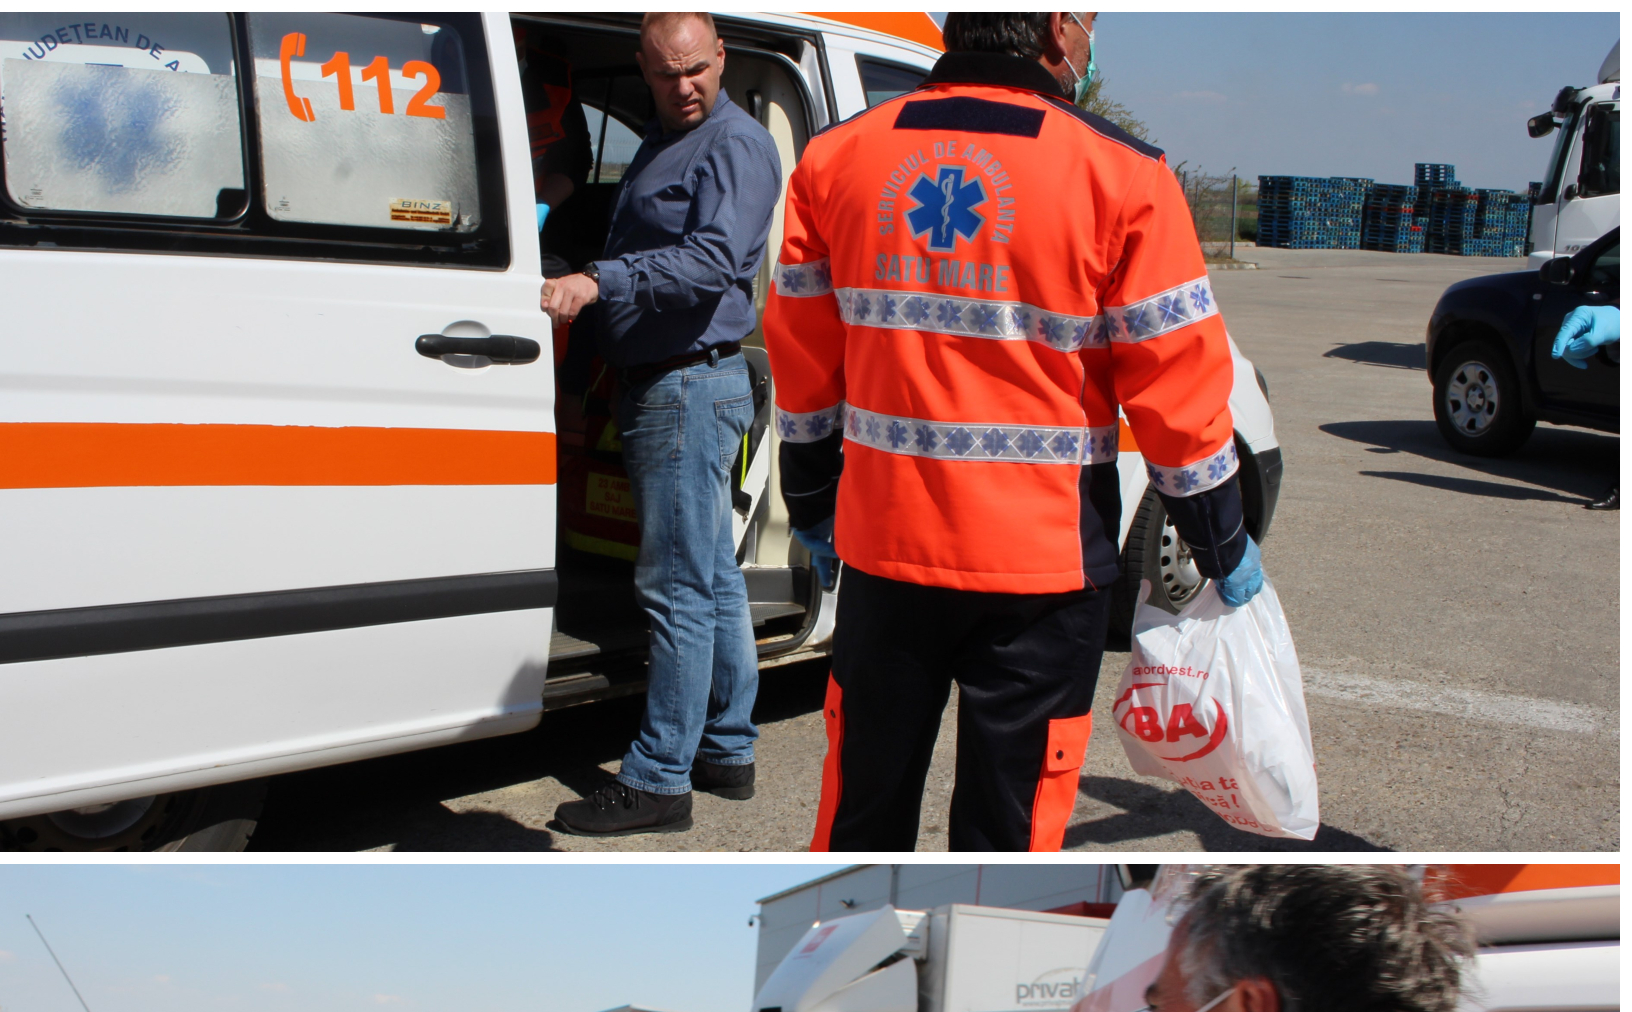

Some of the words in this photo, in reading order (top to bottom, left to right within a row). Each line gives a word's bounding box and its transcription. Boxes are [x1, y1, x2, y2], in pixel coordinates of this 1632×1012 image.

[135, 33, 166, 61] DE
[320, 51, 446, 119] 112
[401, 200, 442, 211] BINZ
[877, 149, 930, 236] SERVICIUL
[933, 140, 957, 159] DE
[875, 253, 931, 284] SATU
[937, 258, 1010, 293] MARE
